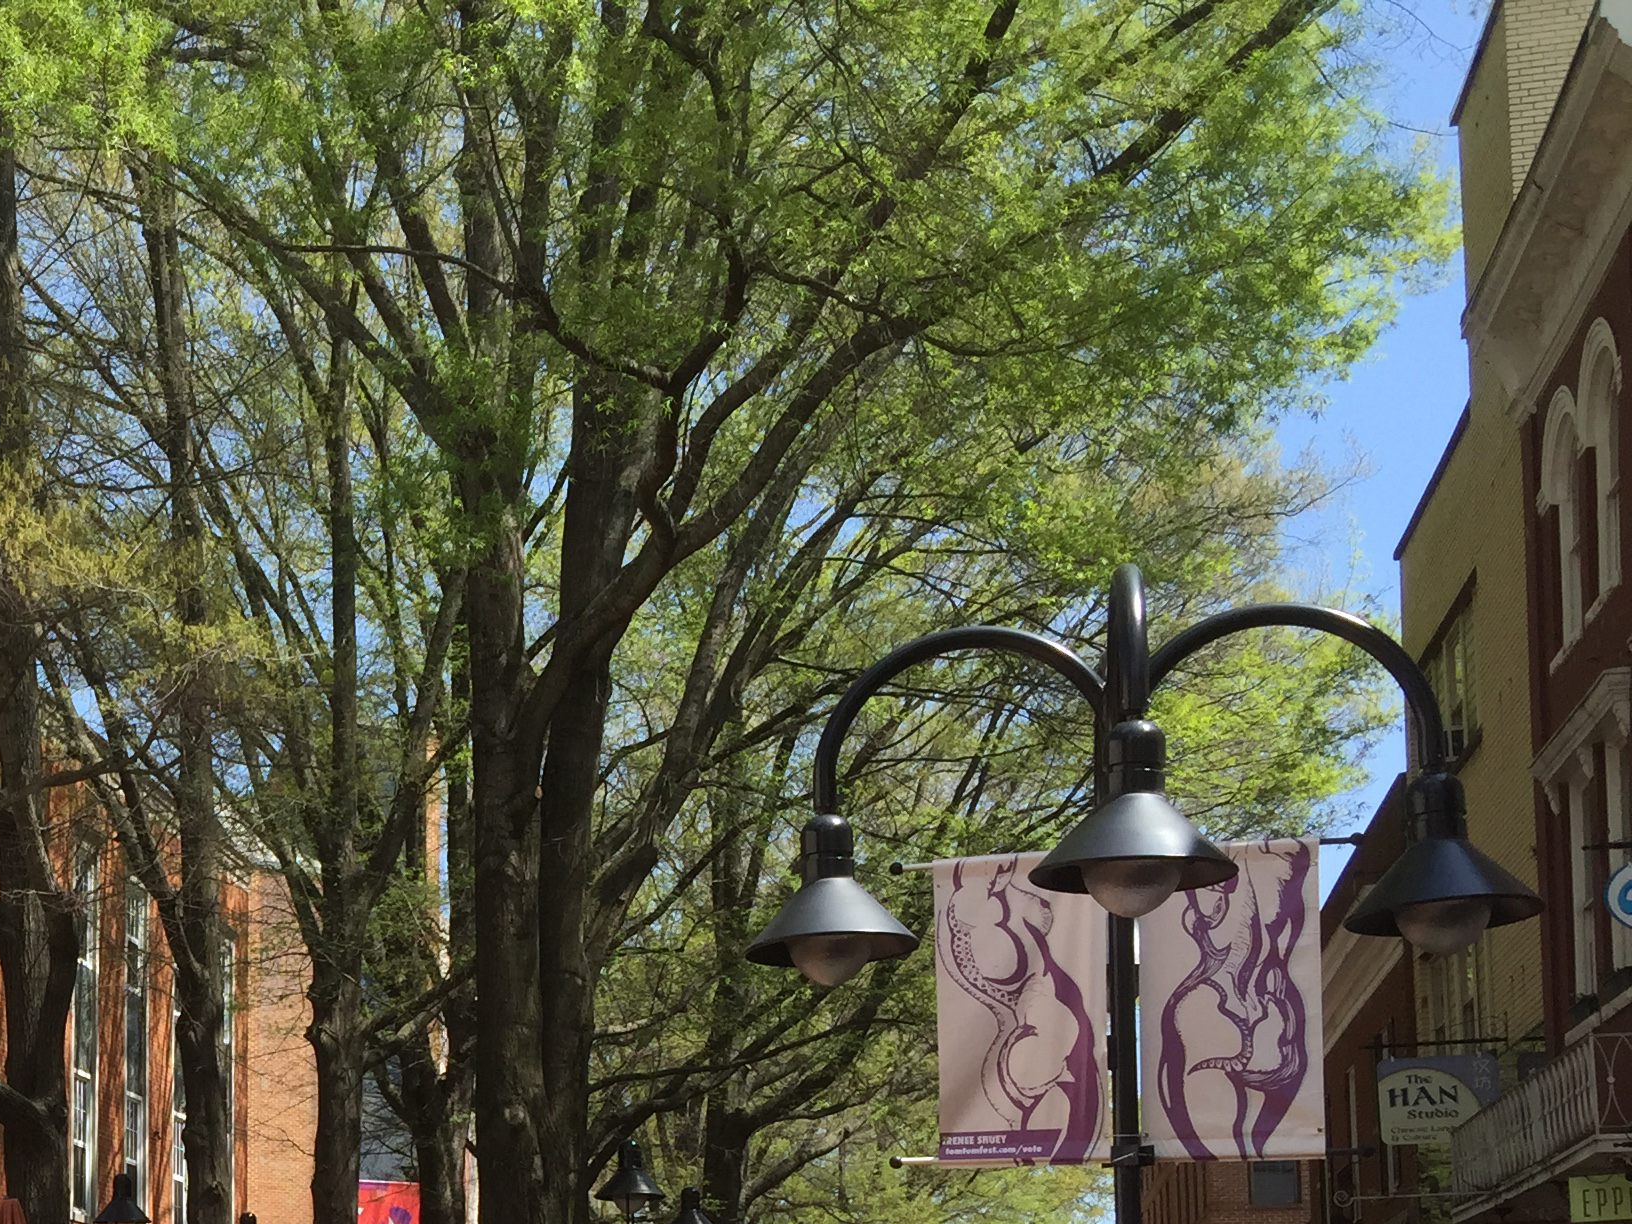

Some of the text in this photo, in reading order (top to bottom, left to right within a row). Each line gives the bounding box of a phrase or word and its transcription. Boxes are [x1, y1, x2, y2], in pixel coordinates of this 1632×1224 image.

[1406, 1074, 1432, 1084] The
[1387, 1085, 1459, 1107] HAN
[1407, 1108, 1459, 1119] Studio
